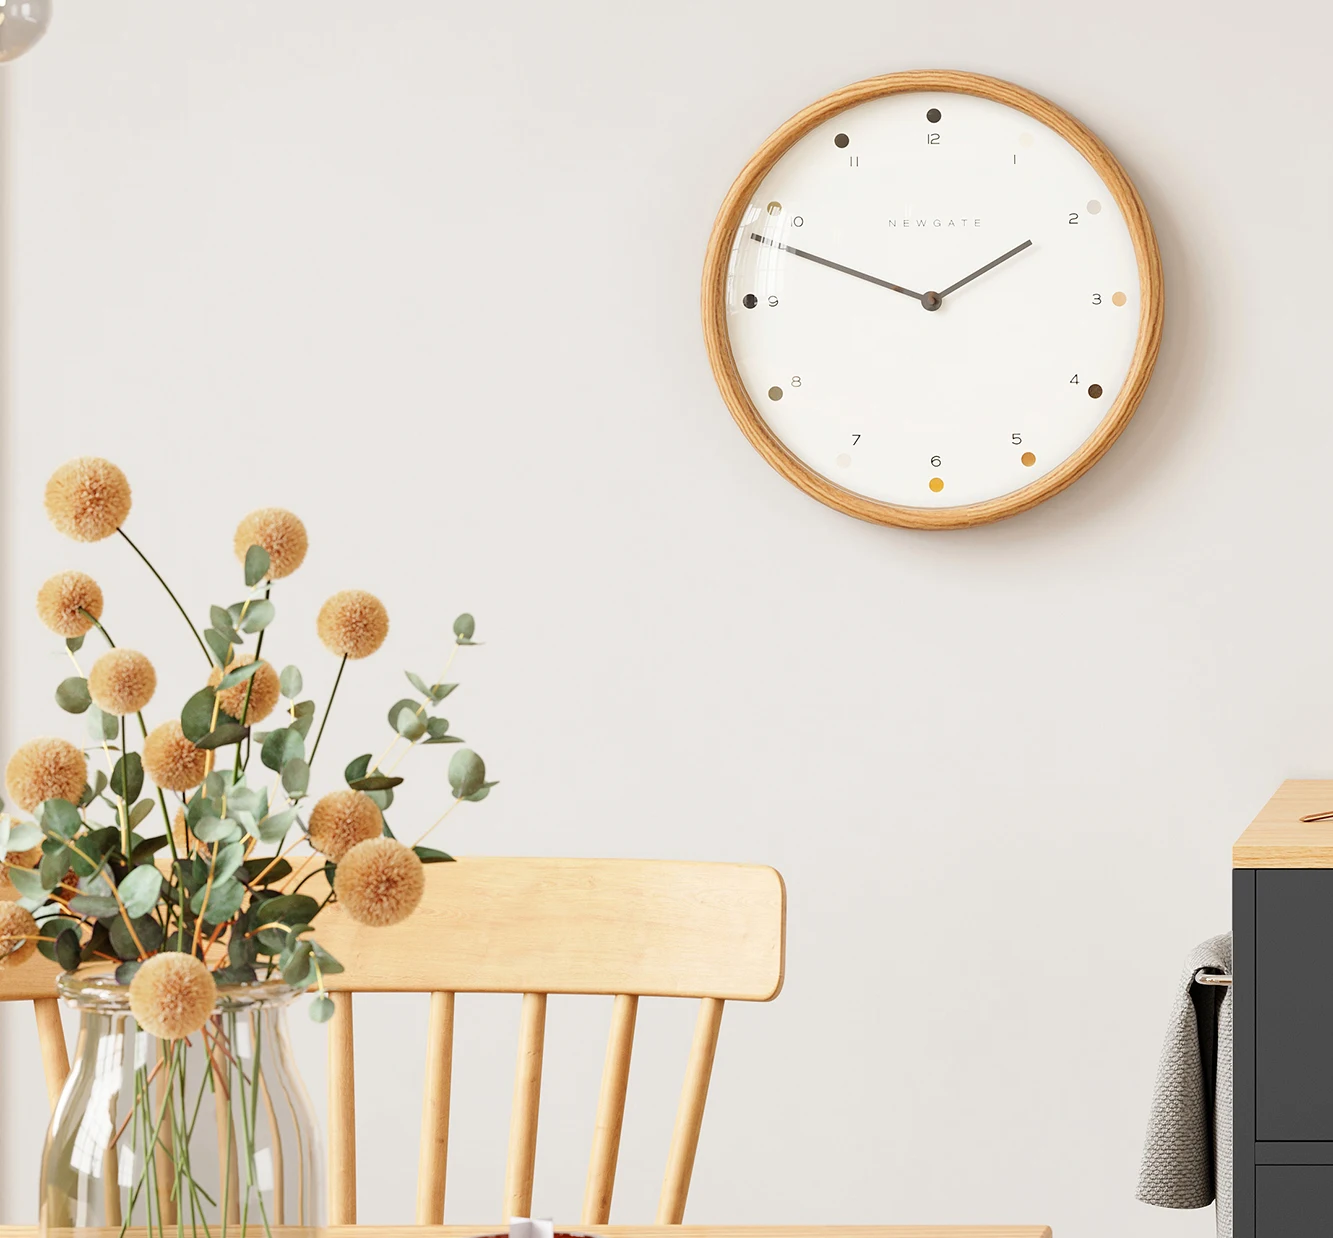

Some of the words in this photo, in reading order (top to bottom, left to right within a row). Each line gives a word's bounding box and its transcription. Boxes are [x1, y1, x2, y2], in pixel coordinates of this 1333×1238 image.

[927, 132, 941, 145] 12
[849, 156, 860, 167] 11
[888, 218, 982, 228] NEWGATE
[1068, 212, 1079, 225] 2
[767, 295, 779, 308] 9
[1091, 292, 1102, 306] 3
[790, 375, 802, 388] 8
[1069, 373, 1081, 386] 4
[851, 433, 862, 447] 7
[1011, 432, 1023, 446] 5
[930, 454, 942, 468] 6
